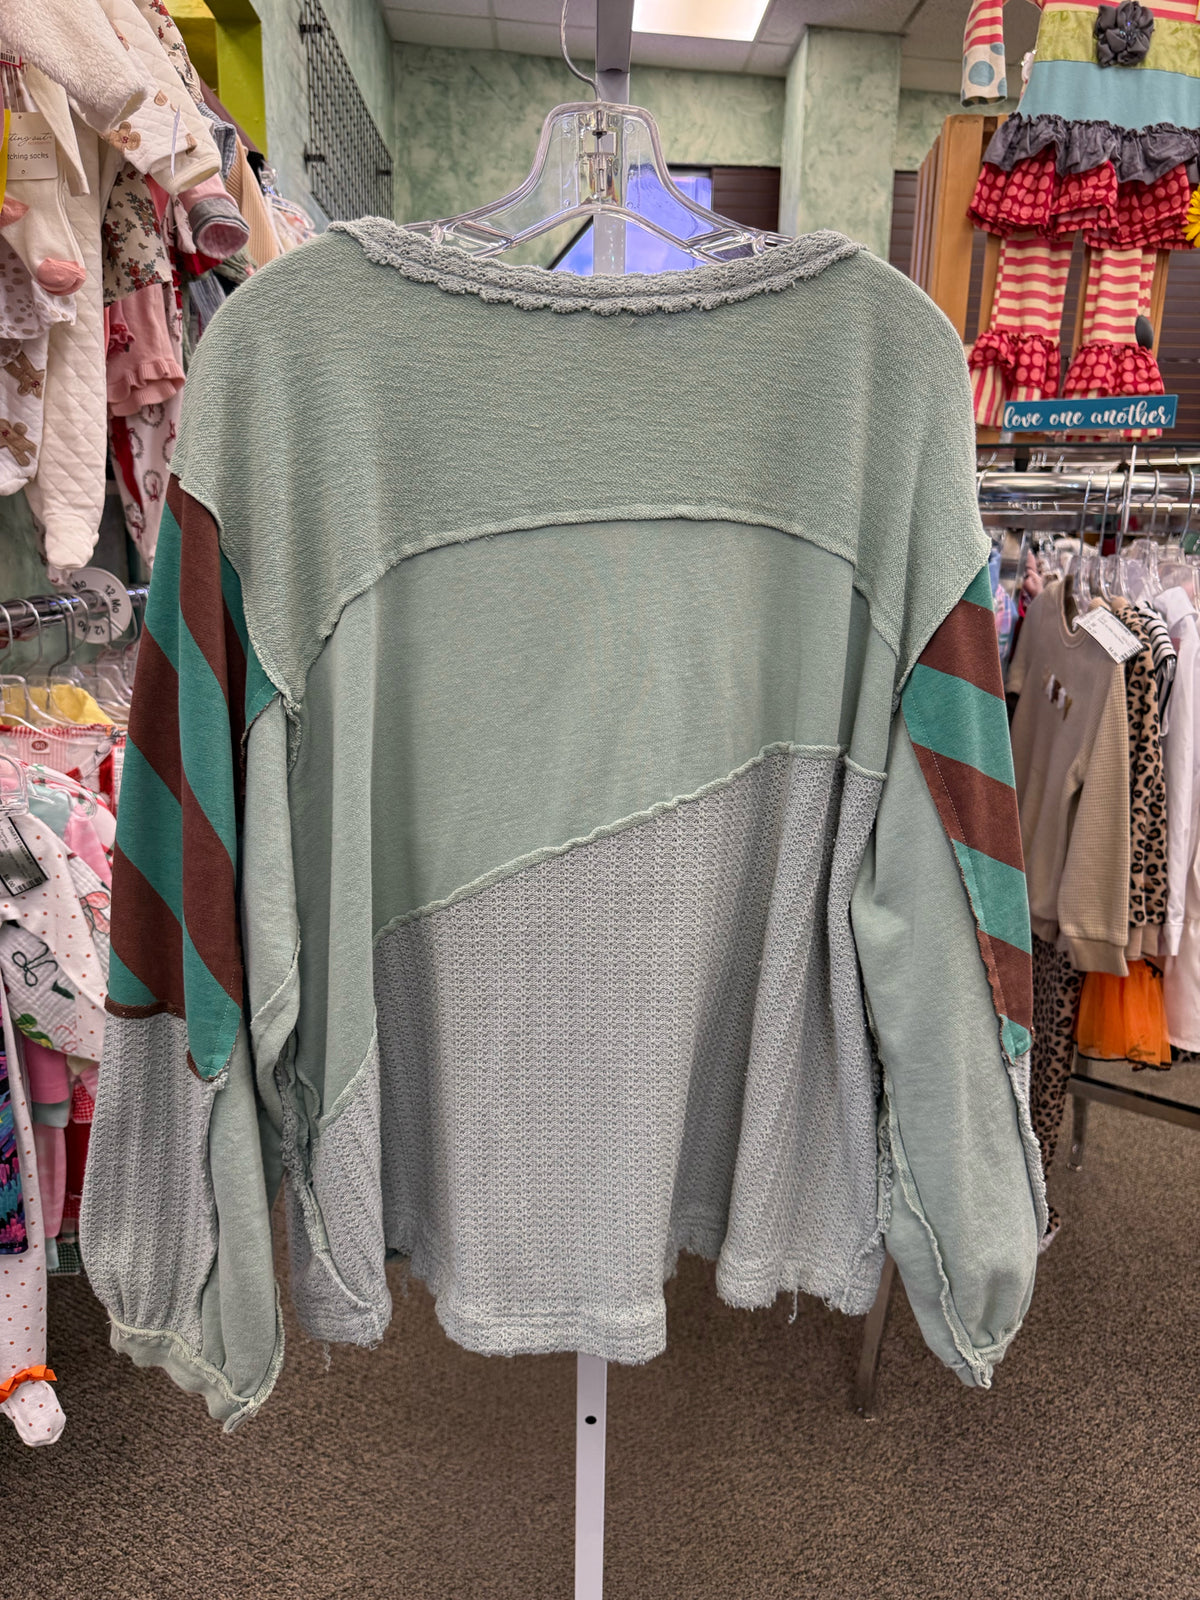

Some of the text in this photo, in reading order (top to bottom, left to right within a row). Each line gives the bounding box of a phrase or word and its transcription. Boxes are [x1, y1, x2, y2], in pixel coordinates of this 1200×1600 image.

[29, 152, 49, 160] socks
[1003, 400, 1171, 429] love one another
[105, 584, 121, 614] 12 Mo
[94, 625, 106, 636] 12
